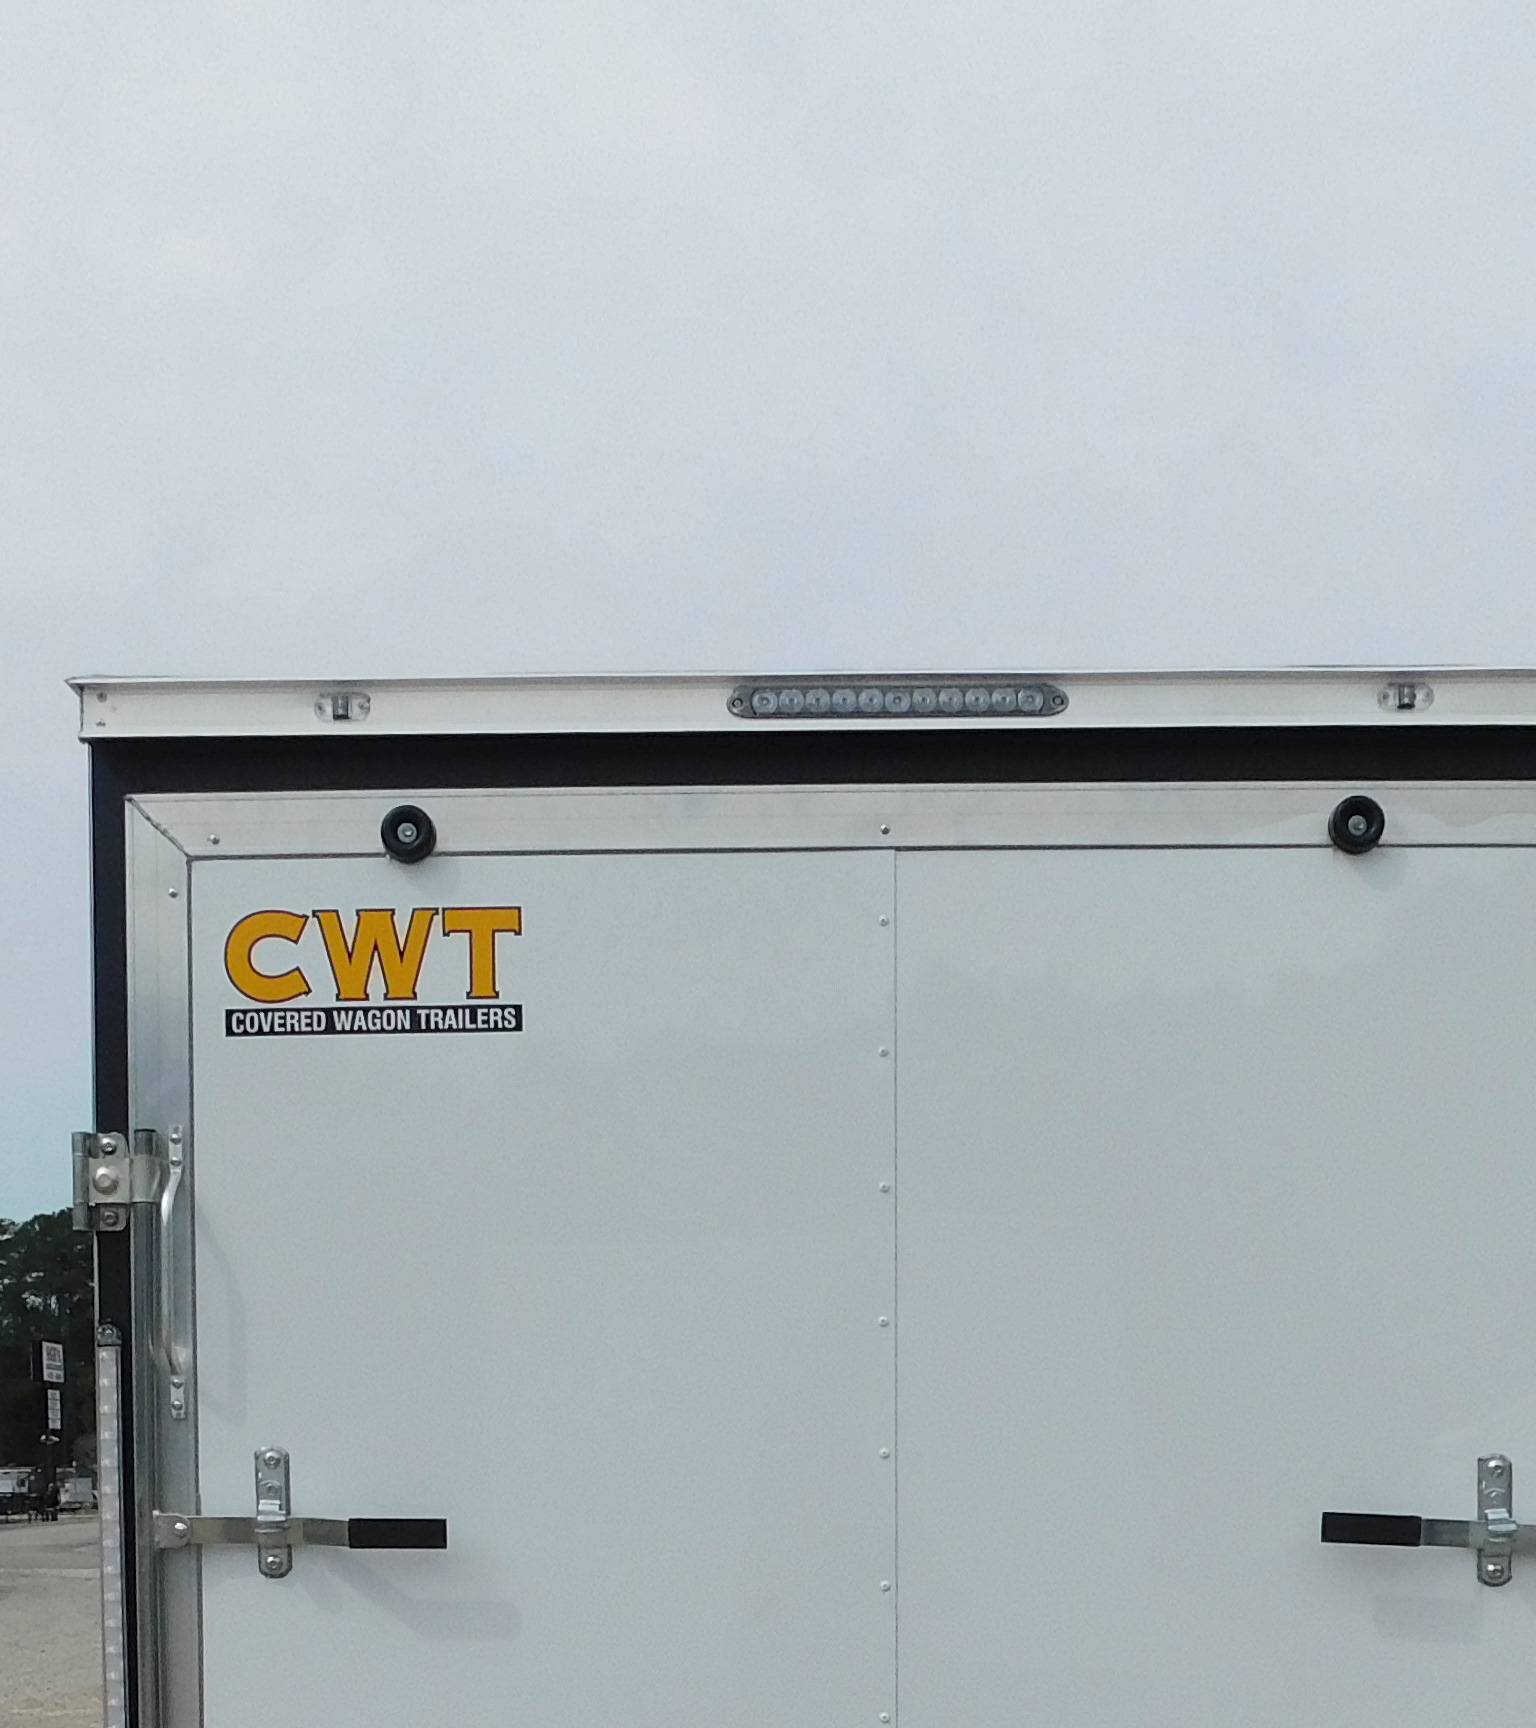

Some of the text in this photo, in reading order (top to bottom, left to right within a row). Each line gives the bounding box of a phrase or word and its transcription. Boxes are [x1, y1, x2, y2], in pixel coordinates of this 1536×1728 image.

[225, 906, 522, 1004] CWT
[231, 1007, 517, 1033] COVERED WAGON TRAILERS
